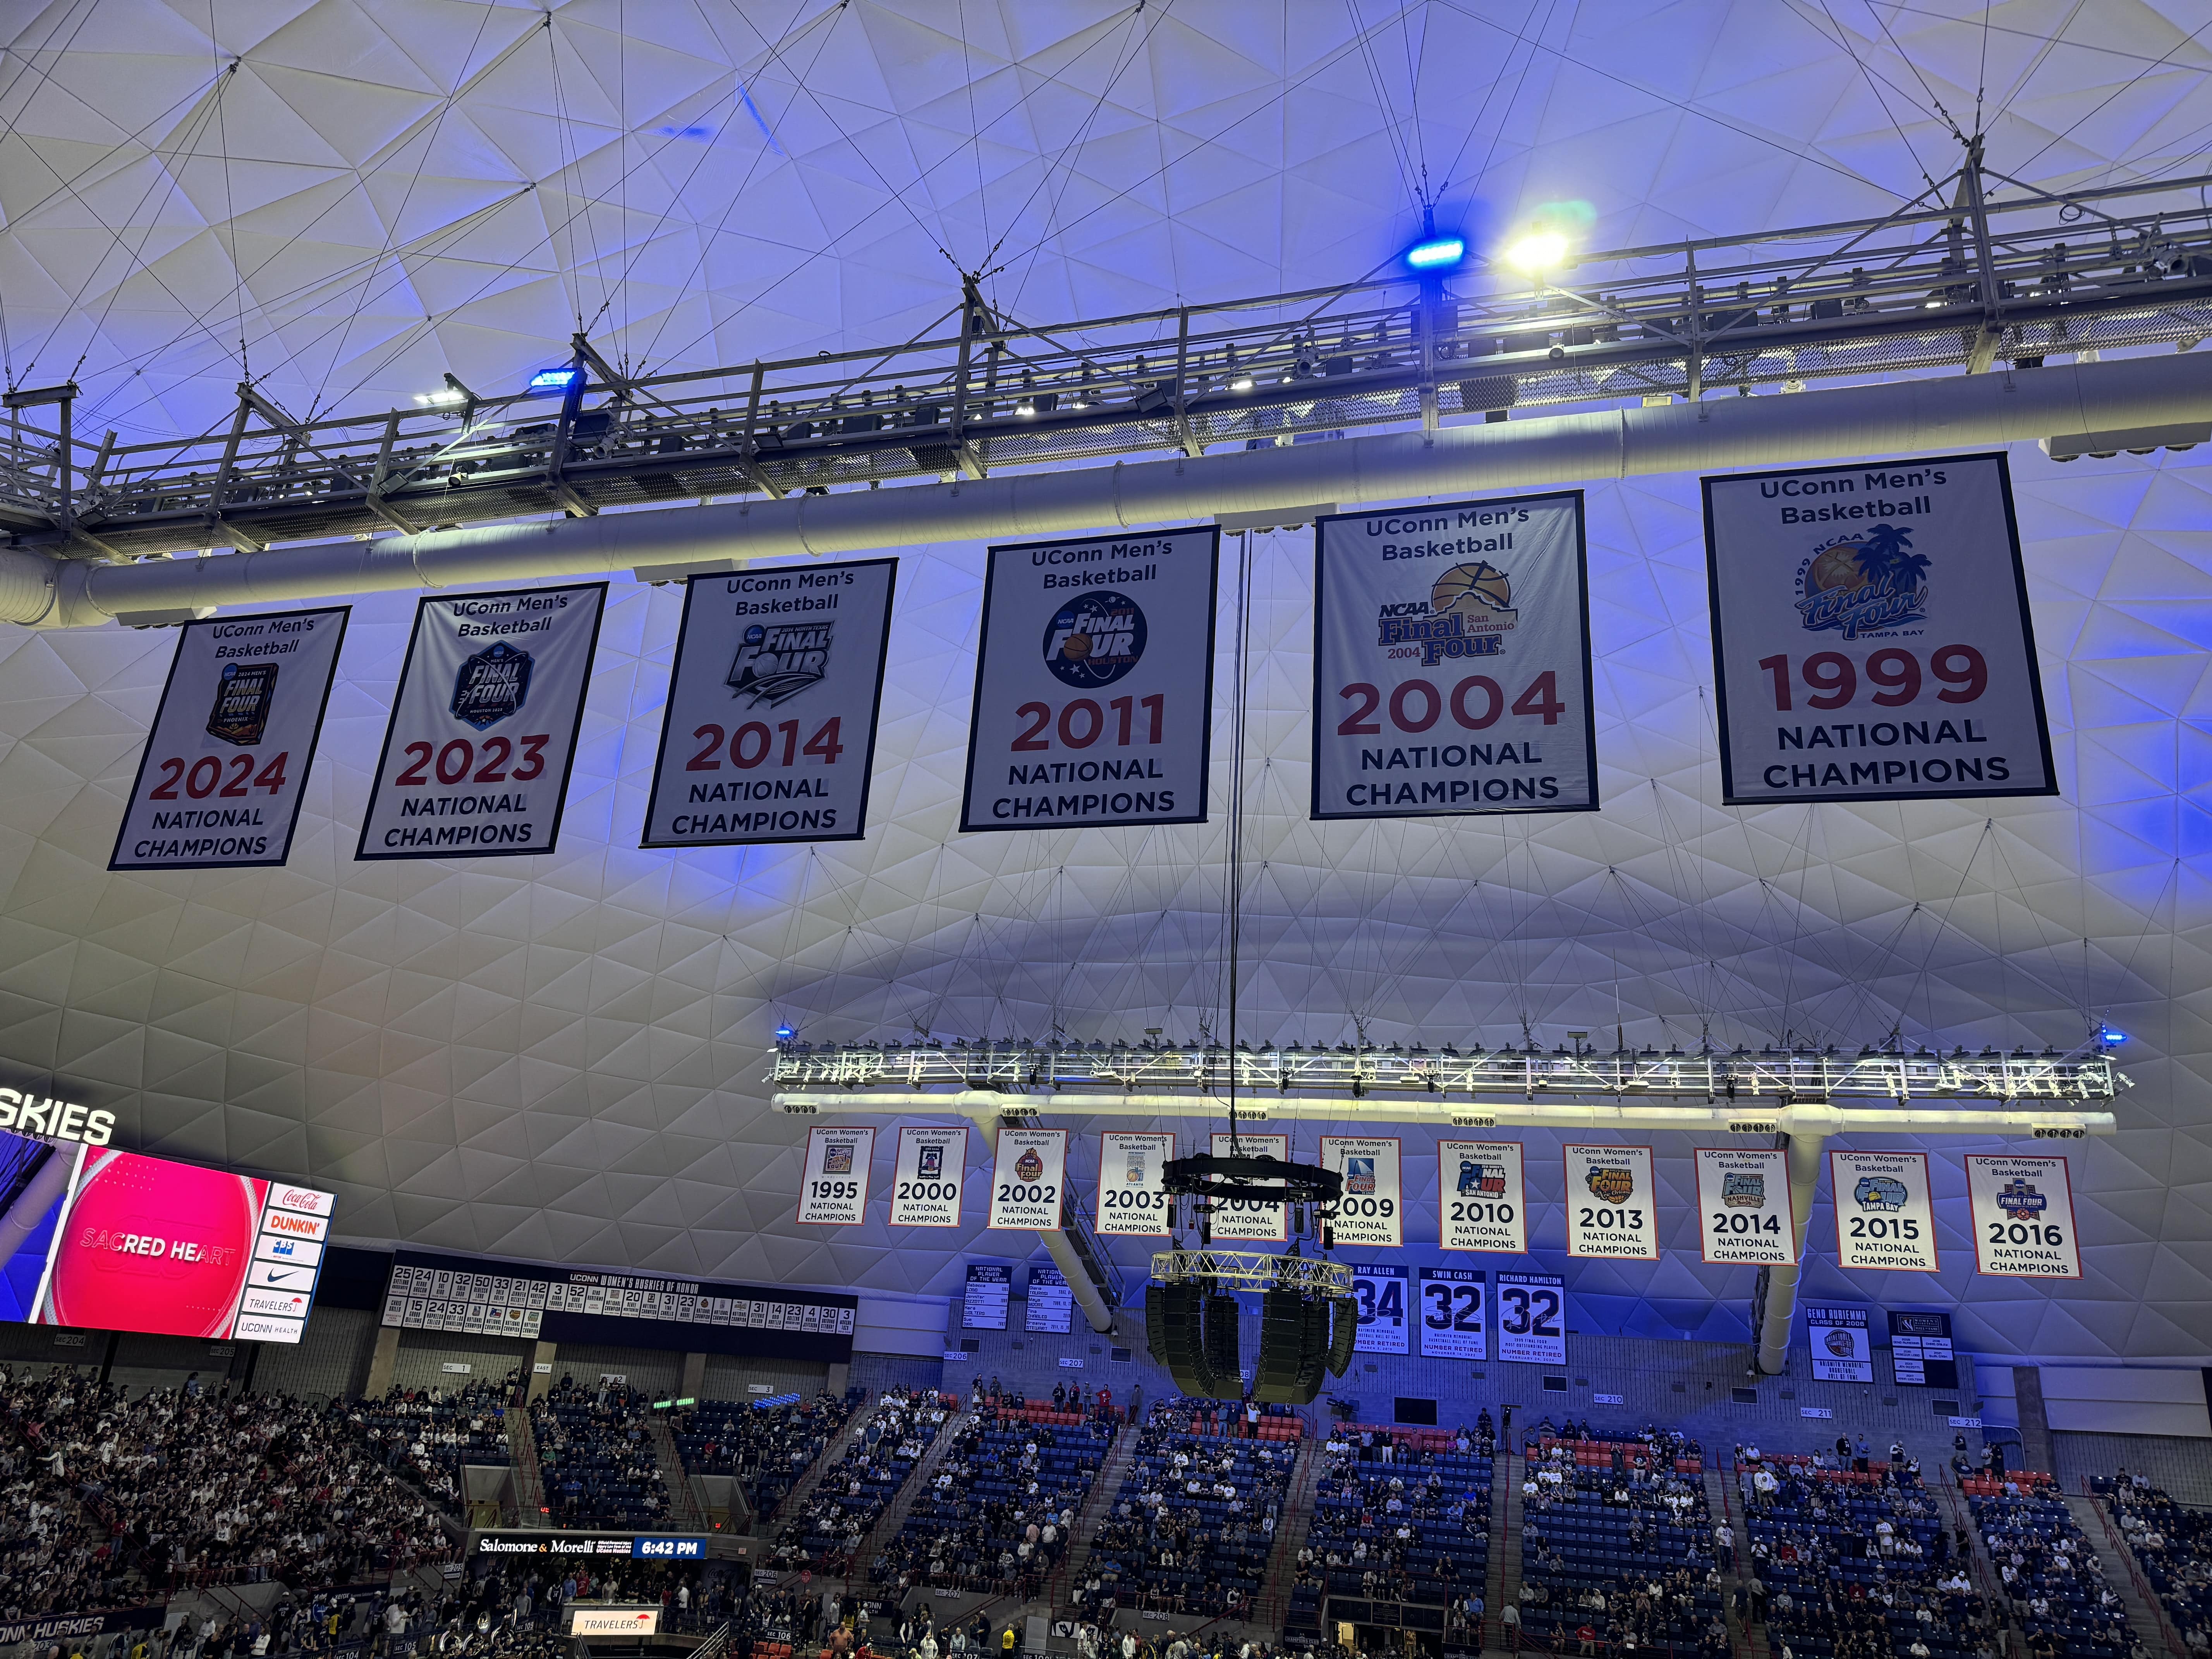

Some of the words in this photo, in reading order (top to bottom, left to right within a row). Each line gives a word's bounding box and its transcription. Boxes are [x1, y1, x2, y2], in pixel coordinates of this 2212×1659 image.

[1760, 478, 1855, 499] UConn
[1865, 469, 1947, 491] Men's
[1781, 496, 1930, 525] Basketball
[1367, 518, 1448, 537] UConn
[1458, 507, 1529, 528] Men's
[1032, 548, 1103, 567] UConn
[1111, 541, 1173, 559] Men's
[1382, 533, 1513, 561] Basketball
[726, 577, 791, 594] UConn
[798, 571, 854, 589] Men's
[1043, 564, 1157, 589] Basketball
[453, 601, 512, 618] UConn
[516, 594, 568, 613] Men's
[735, 594, 838, 616] Basketball
[213, 622, 265, 640] UConn
[268, 618, 314, 633] Men's
[457, 617, 552, 637] Basketball
[1467, 615, 1489, 623] San
[1467, 622, 1515, 633] Antonio
[1379, 613, 1464, 646] Final
[1860, 631, 1899, 639] TAMPA
[215, 639, 299, 659] Basketball
[1388, 647, 1420, 659] 2004
[1421, 634, 1501, 666] Four
[224, 678, 264, 696] FINAL
[1759, 644, 1987, 711] 1999
[220, 696, 260, 713] FOUR
[1338, 671, 1565, 736] 2004
[1010, 693, 1164, 752] 2011
[685, 716, 844, 771] 2014
[1778, 720, 1987, 750] NATIONAL
[395, 734, 550, 786] 2023
[1362, 742, 1542, 770] NATIONAL
[149, 751, 289, 800] 2024
[1008, 758, 1164, 785] NATIONAL
[1763, 757, 2010, 788] CHAMPIONS
[689, 778, 829, 804] NATIONAL
[1346, 776, 1559, 806] CHAMPIONS
[401, 794, 527, 817] NATIONAL
[992, 790, 1174, 819] CHAMPIONS
[152, 808, 264, 830] NATIONAL
[672, 809, 836, 835] CHAMPIONS
[384, 823, 532, 848] CHAMPIONS
[134, 836, 267, 859] CHAMPIONS
[0, 1088, 116, 1145] SKIES
[1855, 1164, 1903, 1173] Basketball
[1874, 1155, 1917, 1163] Women's
[1992, 1168, 2042, 1177] Basketball
[812, 1182, 857, 1199] 1995
[898, 1183, 957, 1200] 2000
[998, 1184, 1056, 1203] 2002
[898, 1215, 951, 1223] CHAMPIONS
[1002, 1206, 1049, 1215] NATIONAL
[1451, 1202, 1514, 1223] 2010
[1580, 1208, 1643, 1229] 2013
[271, 1216, 320, 1235] DUNKIN'
[997, 1218, 1051, 1226] CHAMPIONS
[1455, 1226, 1510, 1236] NATIONAL
[1713, 1213, 1780, 1234] 2014
[1850, 1217, 1919, 1239] 2015
[1451, 1238, 1516, 1248] CHAMPIONS
[1583, 1232, 1642, 1242] NATIONAL
[1717, 1238, 1779, 1248] NATIONAL
[1989, 1223, 2063, 1246] 2016
[80, 1227, 166, 1257] SACRED
[170, 1242, 235, 1266] HEART
[273, 1239, 294, 1255] CBS
[1579, 1245, 1647, 1255] CHAMPIONS
[1714, 1250, 1785, 1261] CHAMPIONS
[1855, 1242, 1920, 1253] NATIONAL
[1994, 1249, 2061, 1260] NATIONAL
[1851, 1255, 1926, 1267] CHAMPIONS
[1990, 1262, 2068, 1274] CHAMPIONS
[570, 1274, 598, 1283] UCONN
[601, 1274, 634, 1289] WOMEN'S
[634, 1278, 665, 1291] HUSKIES
[667, 1281, 675, 1292] OF
[676, 1282, 699, 1293] HONOR
[1454, 1272, 1472, 1280] CASH
[1499, 1274, 1528, 1283] RICHARD
[1529, 1276, 1561, 1285] HAMILTON
[250, 1299, 292, 1311] TRAVELERS
[1425, 1284, 1481, 1332] 32
[1502, 1288, 1560, 1337] 32
[241, 1322, 272, 1333] UCONN
[66, 1336, 84, 1345] 204
[480, 1539, 538, 1553] Salomone
[539, 1544, 547, 1553] &
[551, 1540, 594, 1553] Morelli
[642, 1542, 673, 1554] 6:42
[677, 1543, 697, 1554] PM
[584, 1620, 638, 1629] TRAVELERS
[778, 1632, 791, 1640] 106
